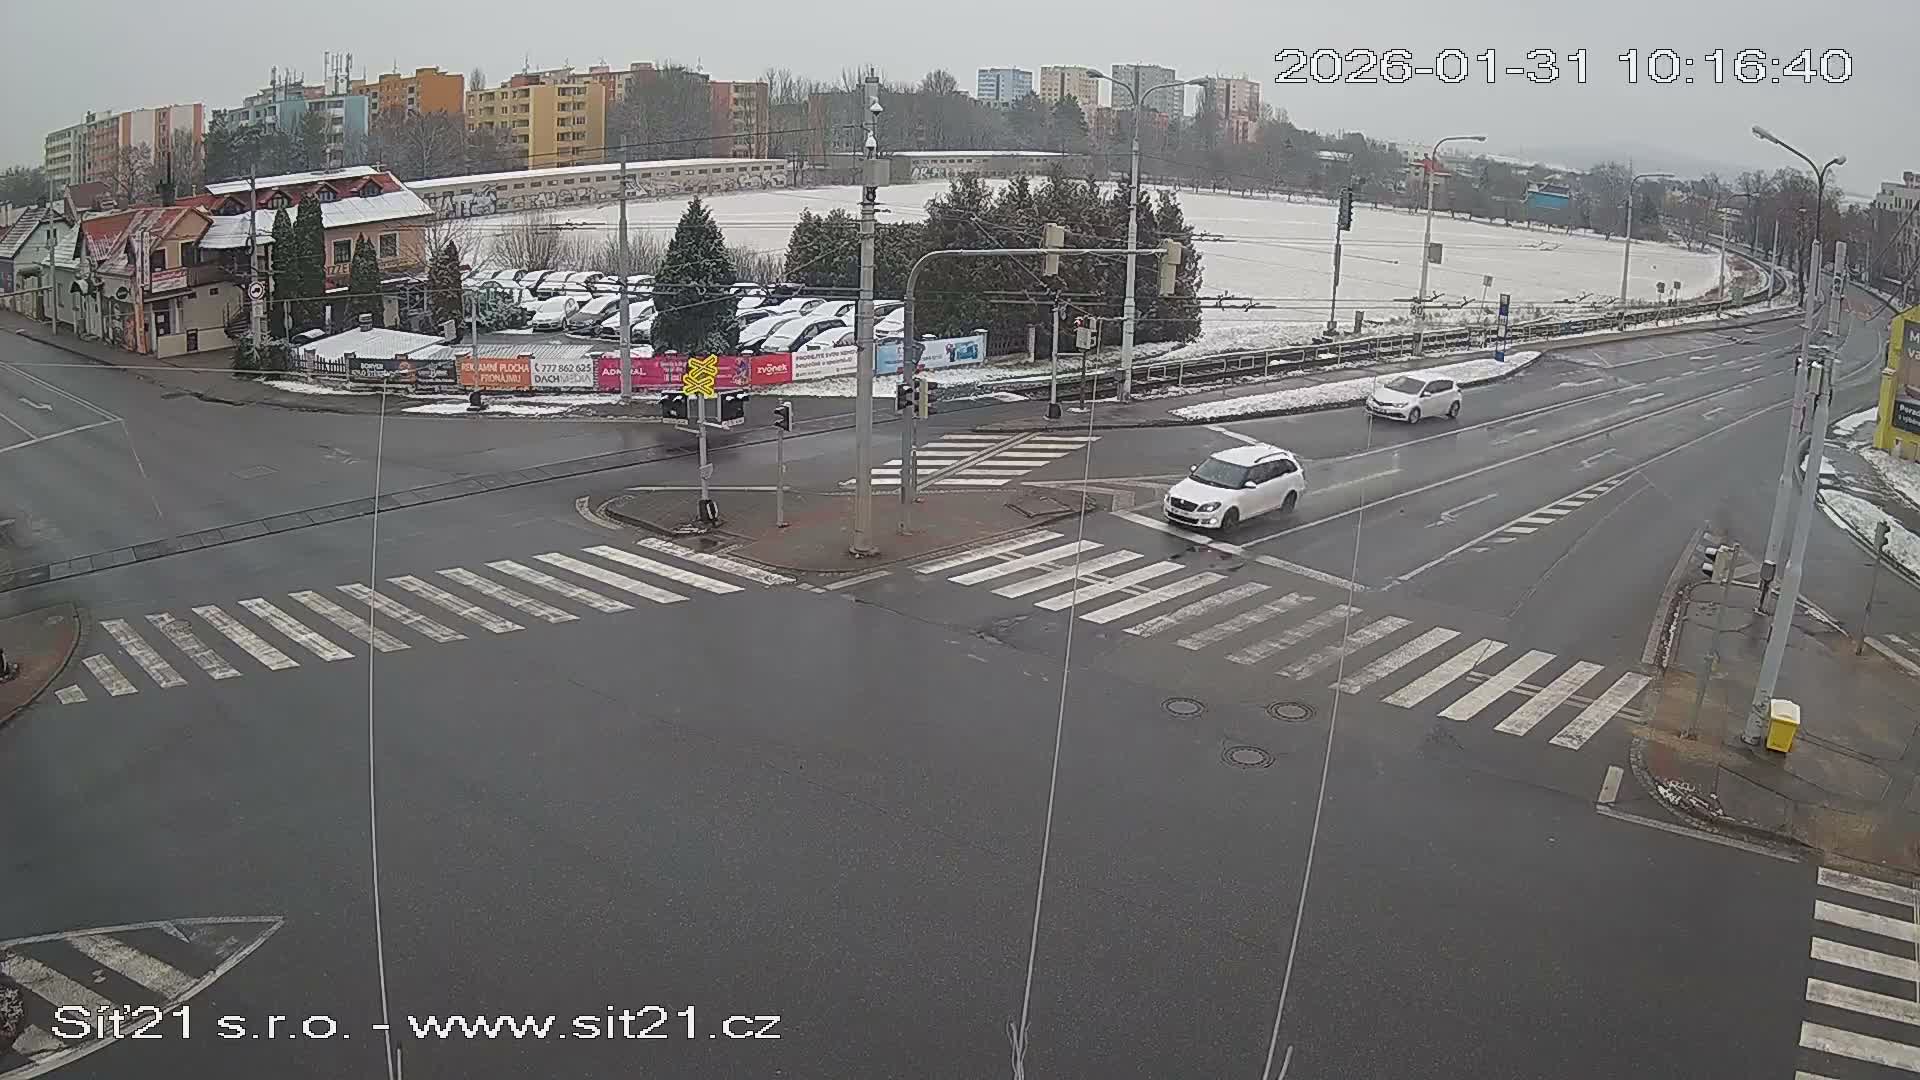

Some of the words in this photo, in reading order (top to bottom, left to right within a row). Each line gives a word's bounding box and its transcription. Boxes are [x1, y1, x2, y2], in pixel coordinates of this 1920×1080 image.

[461, 362, 497, 373] REKAMNÍ
[499, 363, 530, 373] PLOCHA
[541, 364, 557, 373] 777
[558, 364, 573, 372] 862
[575, 363, 592, 372] 625
[601, 367, 647, 376] ADMRAL
